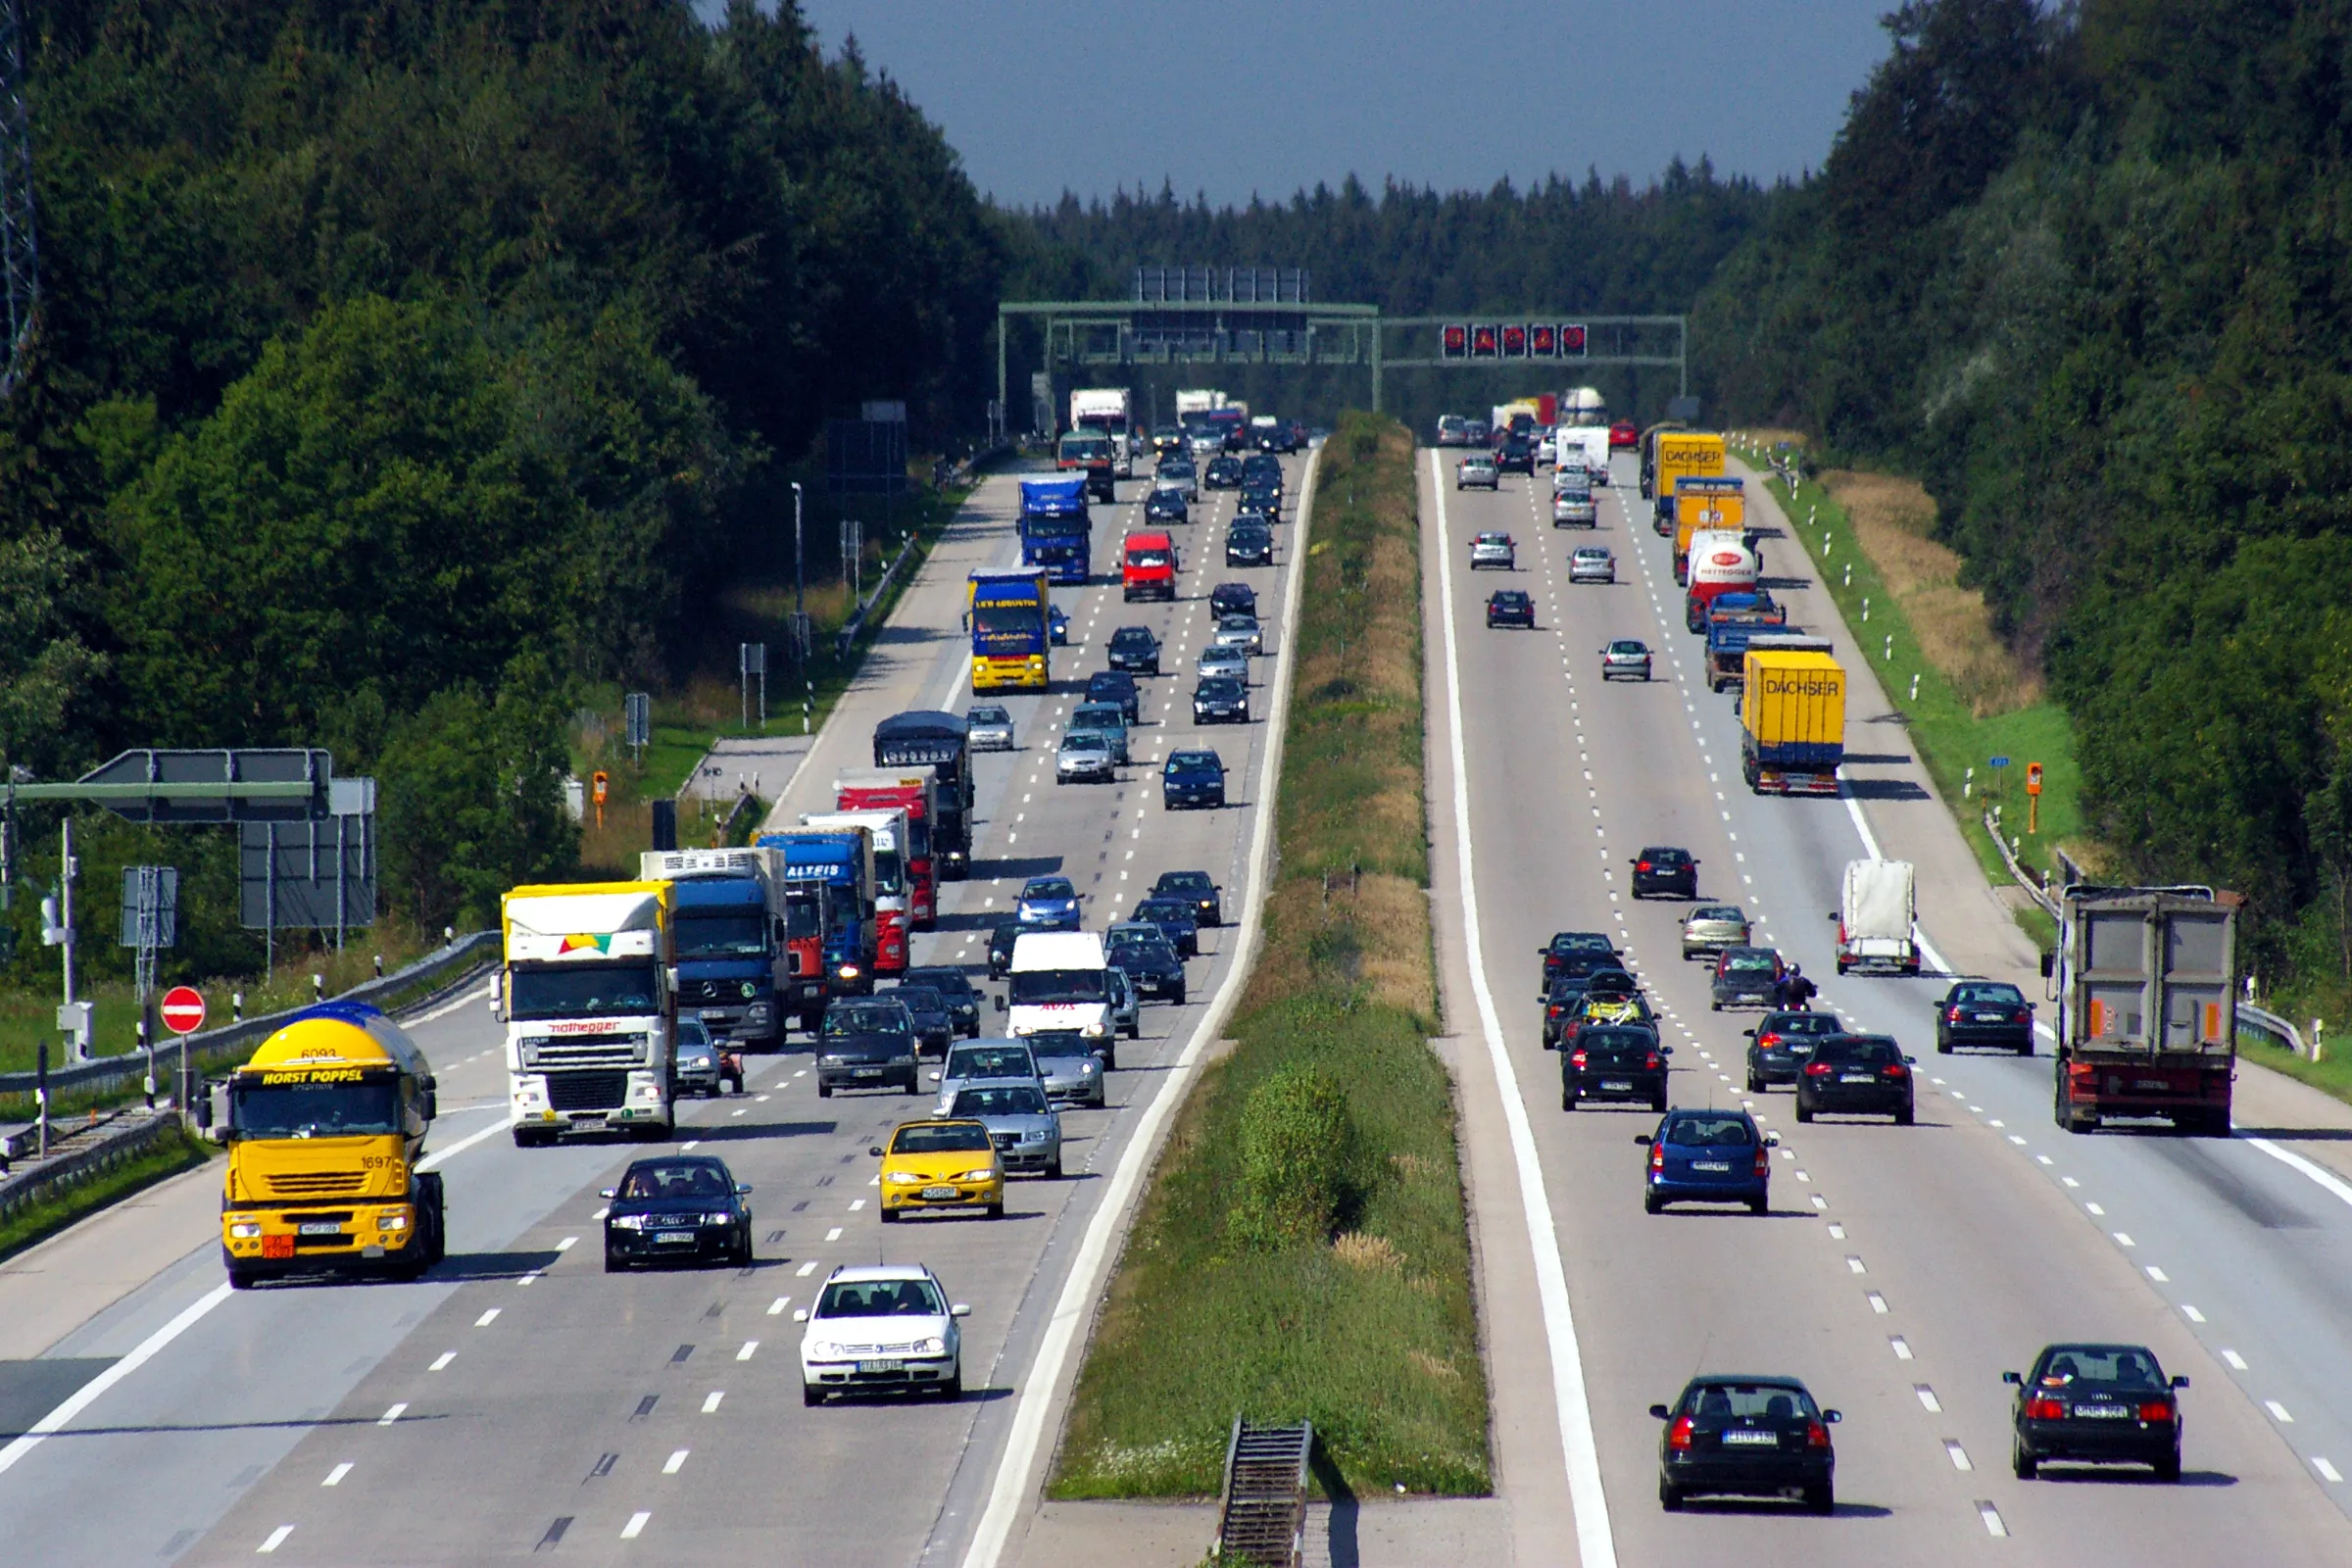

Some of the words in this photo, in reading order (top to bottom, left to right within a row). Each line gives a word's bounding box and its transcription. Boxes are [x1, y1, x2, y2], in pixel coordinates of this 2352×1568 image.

[1665, 450, 1721, 463] DACHSER
[1766, 679, 1839, 697] DACHSER
[263, 1071, 309, 1085] HORST
[311, 1069, 364, 1083] POPPEL
[361, 1156, 392, 1169] 1697
